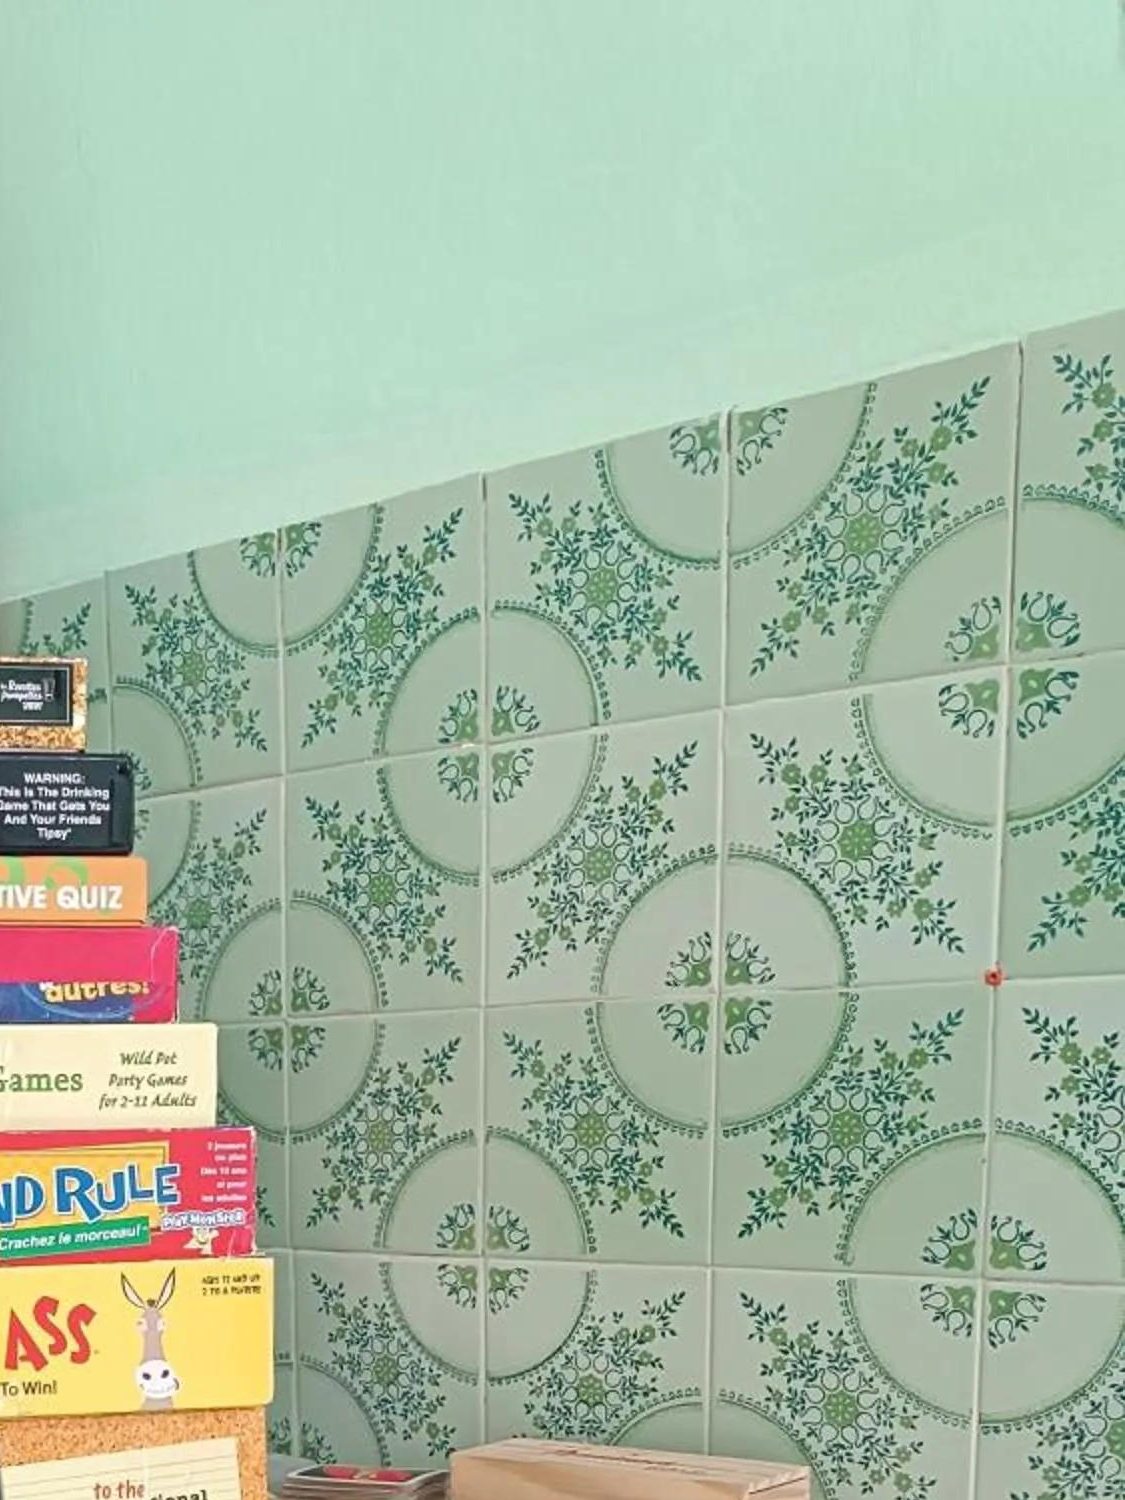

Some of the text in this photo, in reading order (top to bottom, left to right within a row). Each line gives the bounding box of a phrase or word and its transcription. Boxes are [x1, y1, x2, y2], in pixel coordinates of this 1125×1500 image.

[23, 773, 85, 784] WARNING:
[24, 786, 34, 797] Is
[37, 786, 58, 797] The
[61, 786, 110, 800] Drinking
[31, 800, 56, 811] That
[59, 800, 86, 811] Gets
[89, 800, 110, 811] You
[4, 814, 101, 825] And Your Friends
[56, 884, 123, 911] QUIZ
[120, 1049, 178, 1065] Wild Pot
[108, 1074, 188, 1090] Party Games
[99, 1094, 117, 1110] for
[151, 1092, 197, 1107] Adults
[55, 1164, 180, 1222] RULE
[58, 1231, 73, 1246] le
[4, 1295, 97, 1372] ASS
[0, 1382, 19, 1397] To
[22, 1380, 58, 1396] Win!
[94, 1480, 145, 1500] to the
